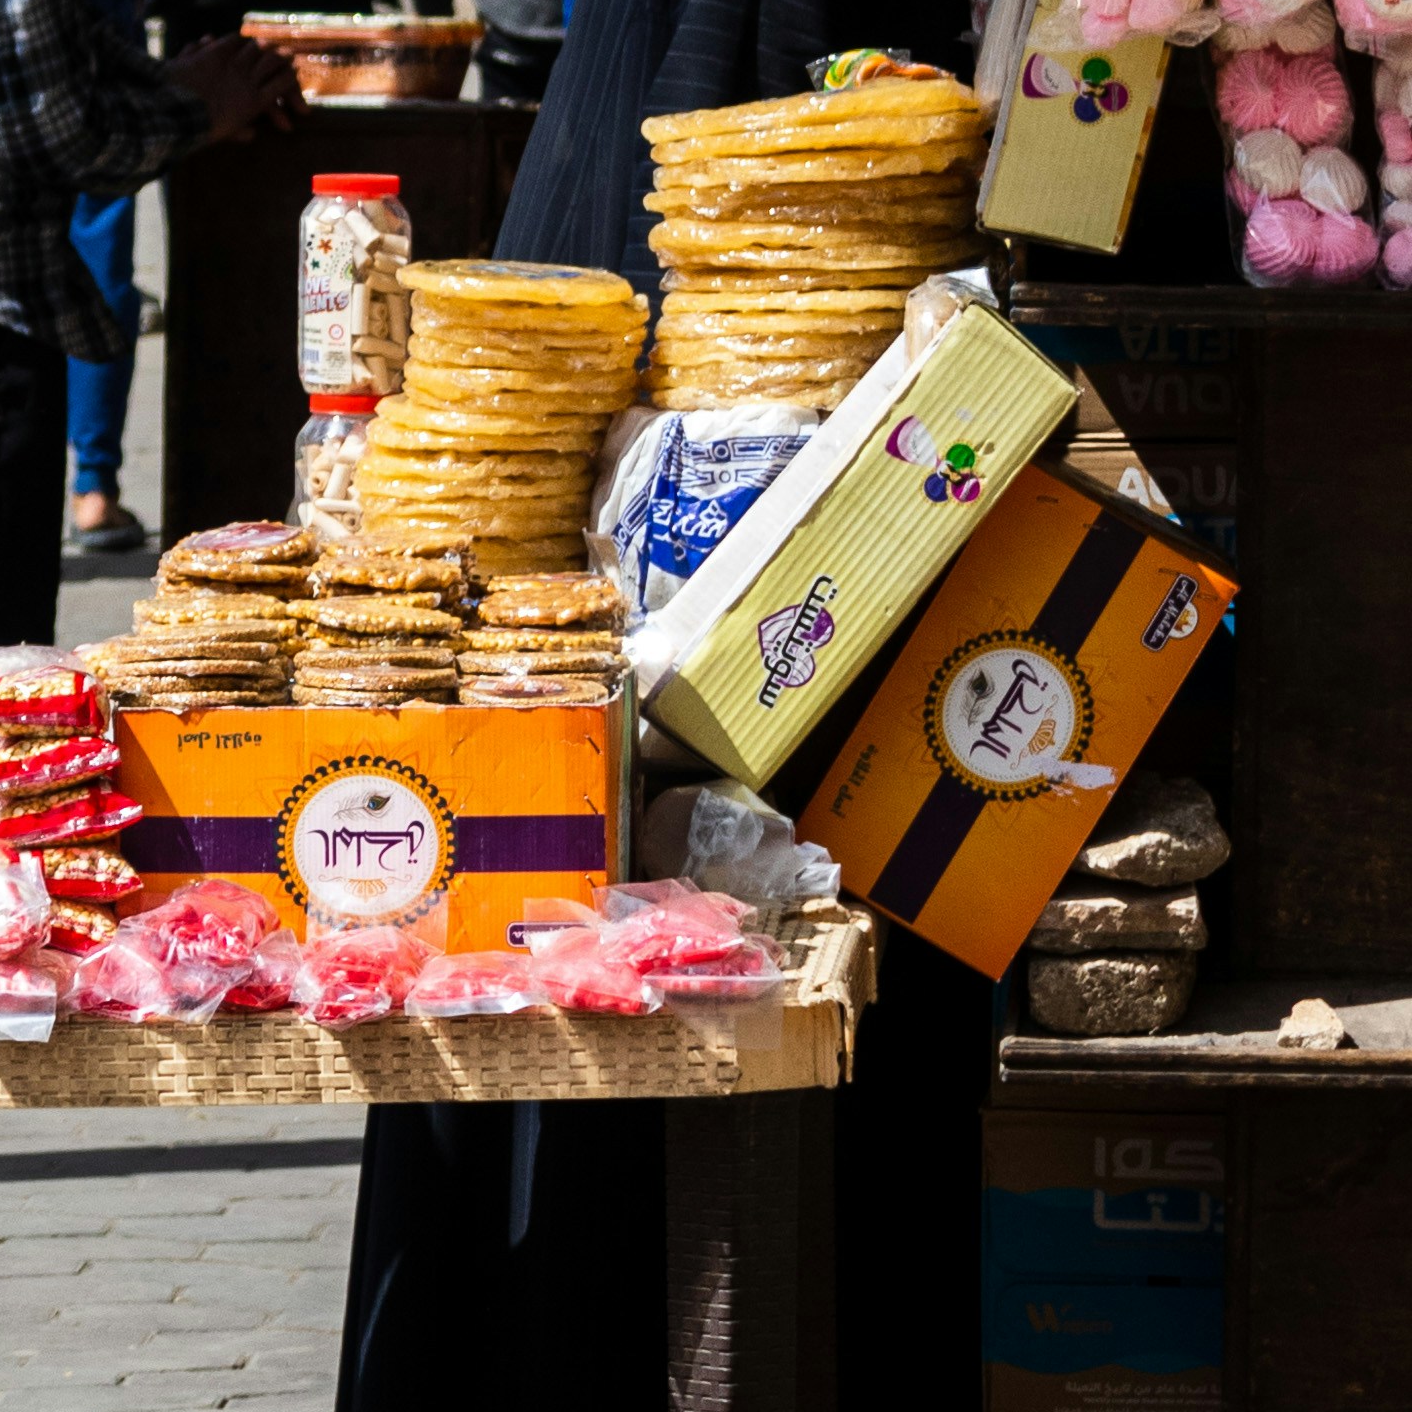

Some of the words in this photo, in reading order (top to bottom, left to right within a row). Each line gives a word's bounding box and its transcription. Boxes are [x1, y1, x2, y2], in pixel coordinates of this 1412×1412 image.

[1117, 324, 1238, 363] ELTA
[1117, 374, 1236, 414] QUA
[759, 575, 838, 709] سويتست
[969, 658, 1048, 760] الملكة
[307, 820, 425, 872] الملكة
[1094, 1137, 1225, 1181] كوا
